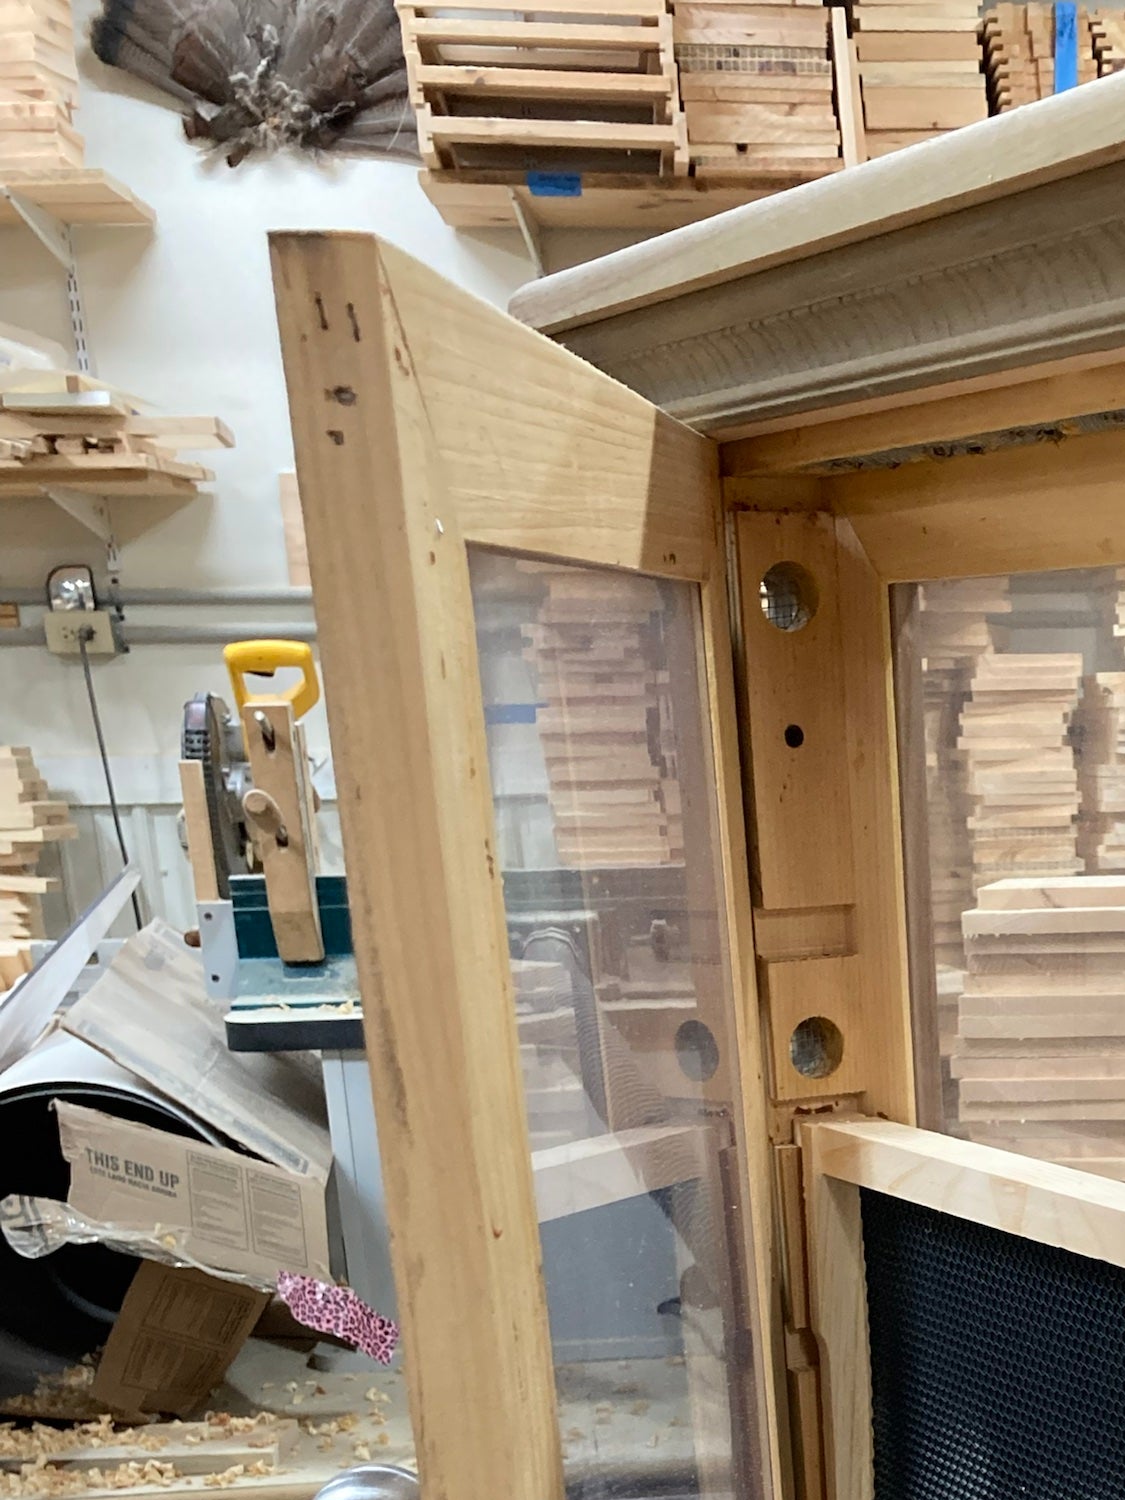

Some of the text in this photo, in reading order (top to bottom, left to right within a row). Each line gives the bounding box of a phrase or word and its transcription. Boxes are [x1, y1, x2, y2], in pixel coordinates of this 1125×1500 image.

[85, 1147, 180, 1188] THIS END UP
